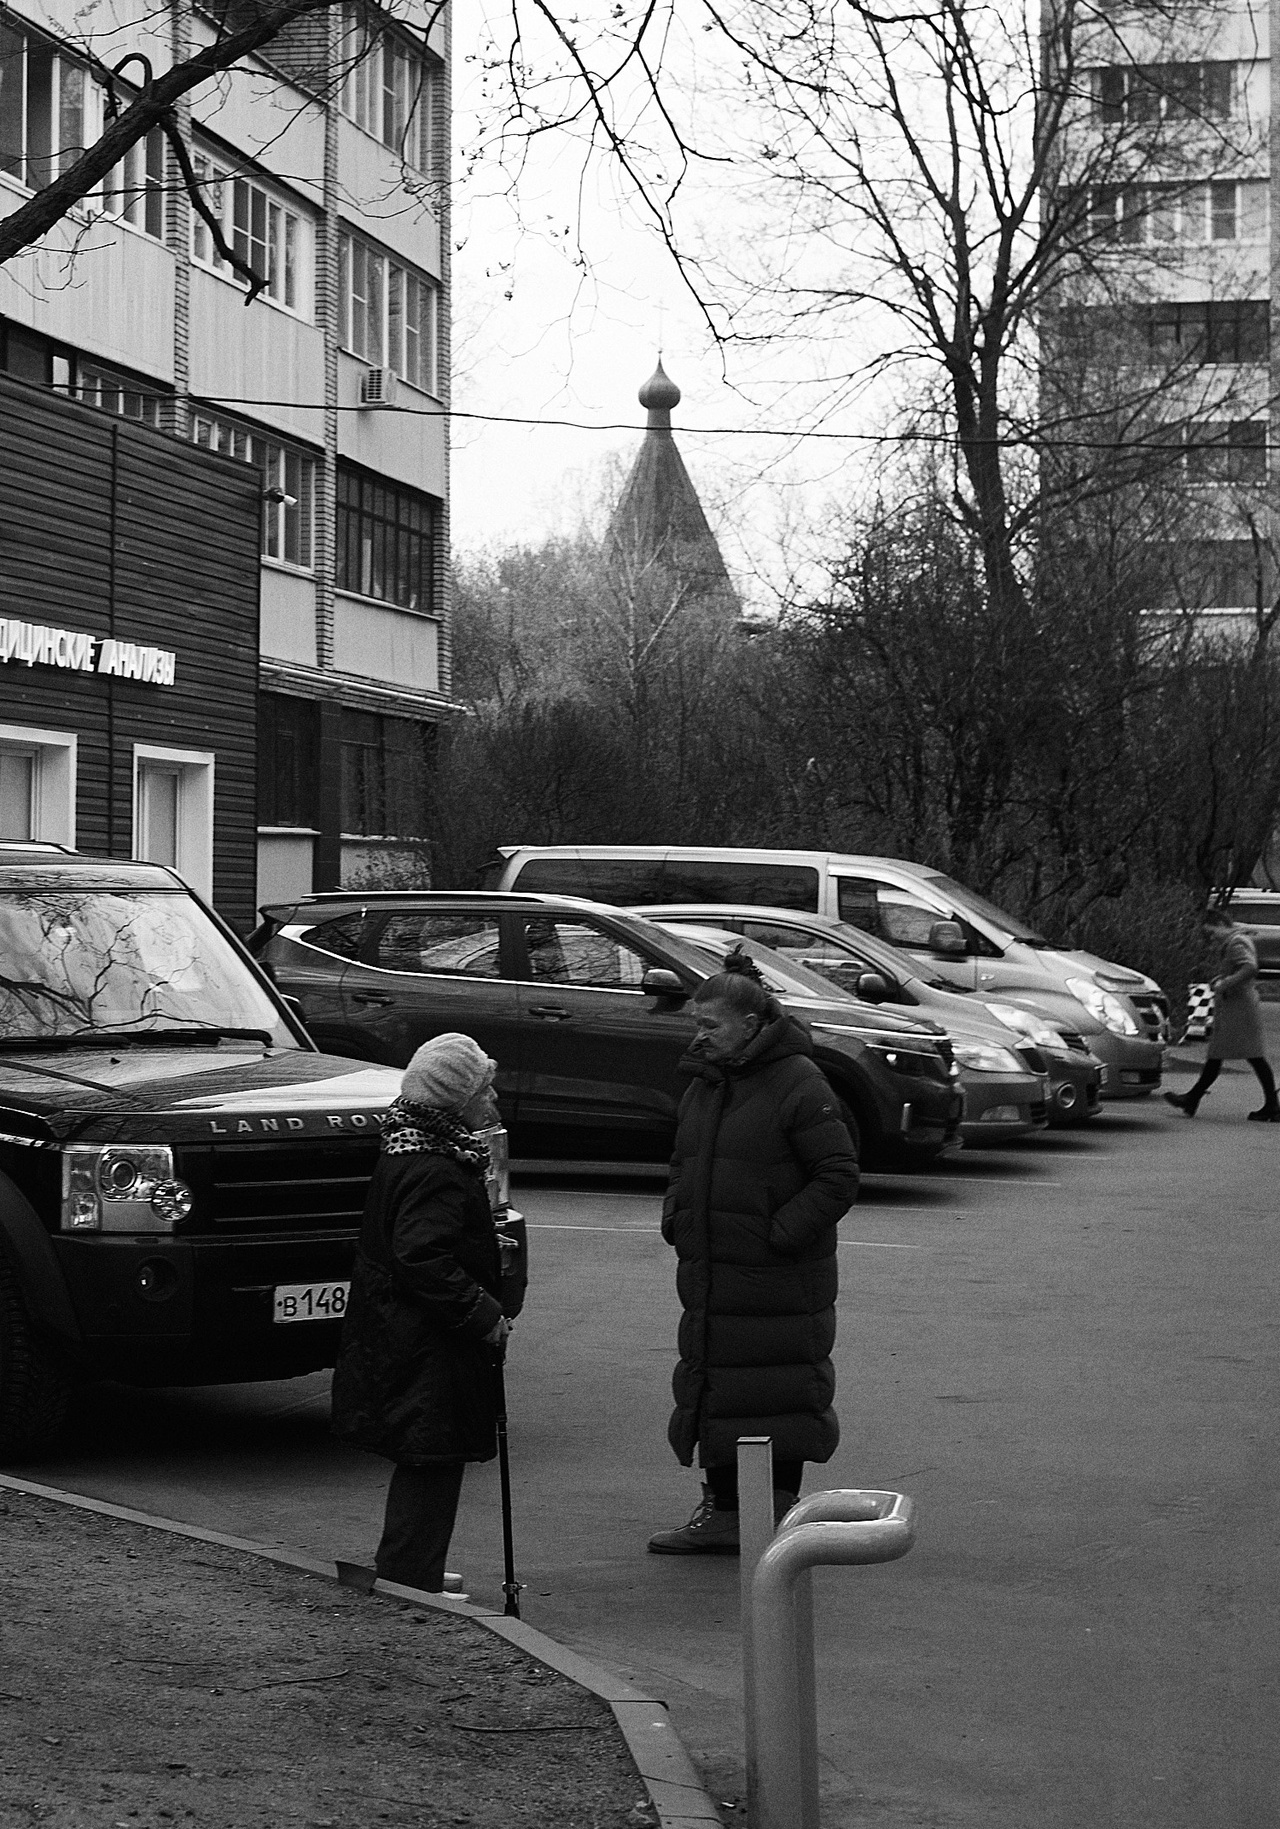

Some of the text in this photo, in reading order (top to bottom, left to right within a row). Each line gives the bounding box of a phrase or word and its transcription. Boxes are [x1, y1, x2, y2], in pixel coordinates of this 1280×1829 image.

[101, 639, 176, 686] АНАЛИЗЫ
[209, 1113, 387, 1135] LAND ROV
